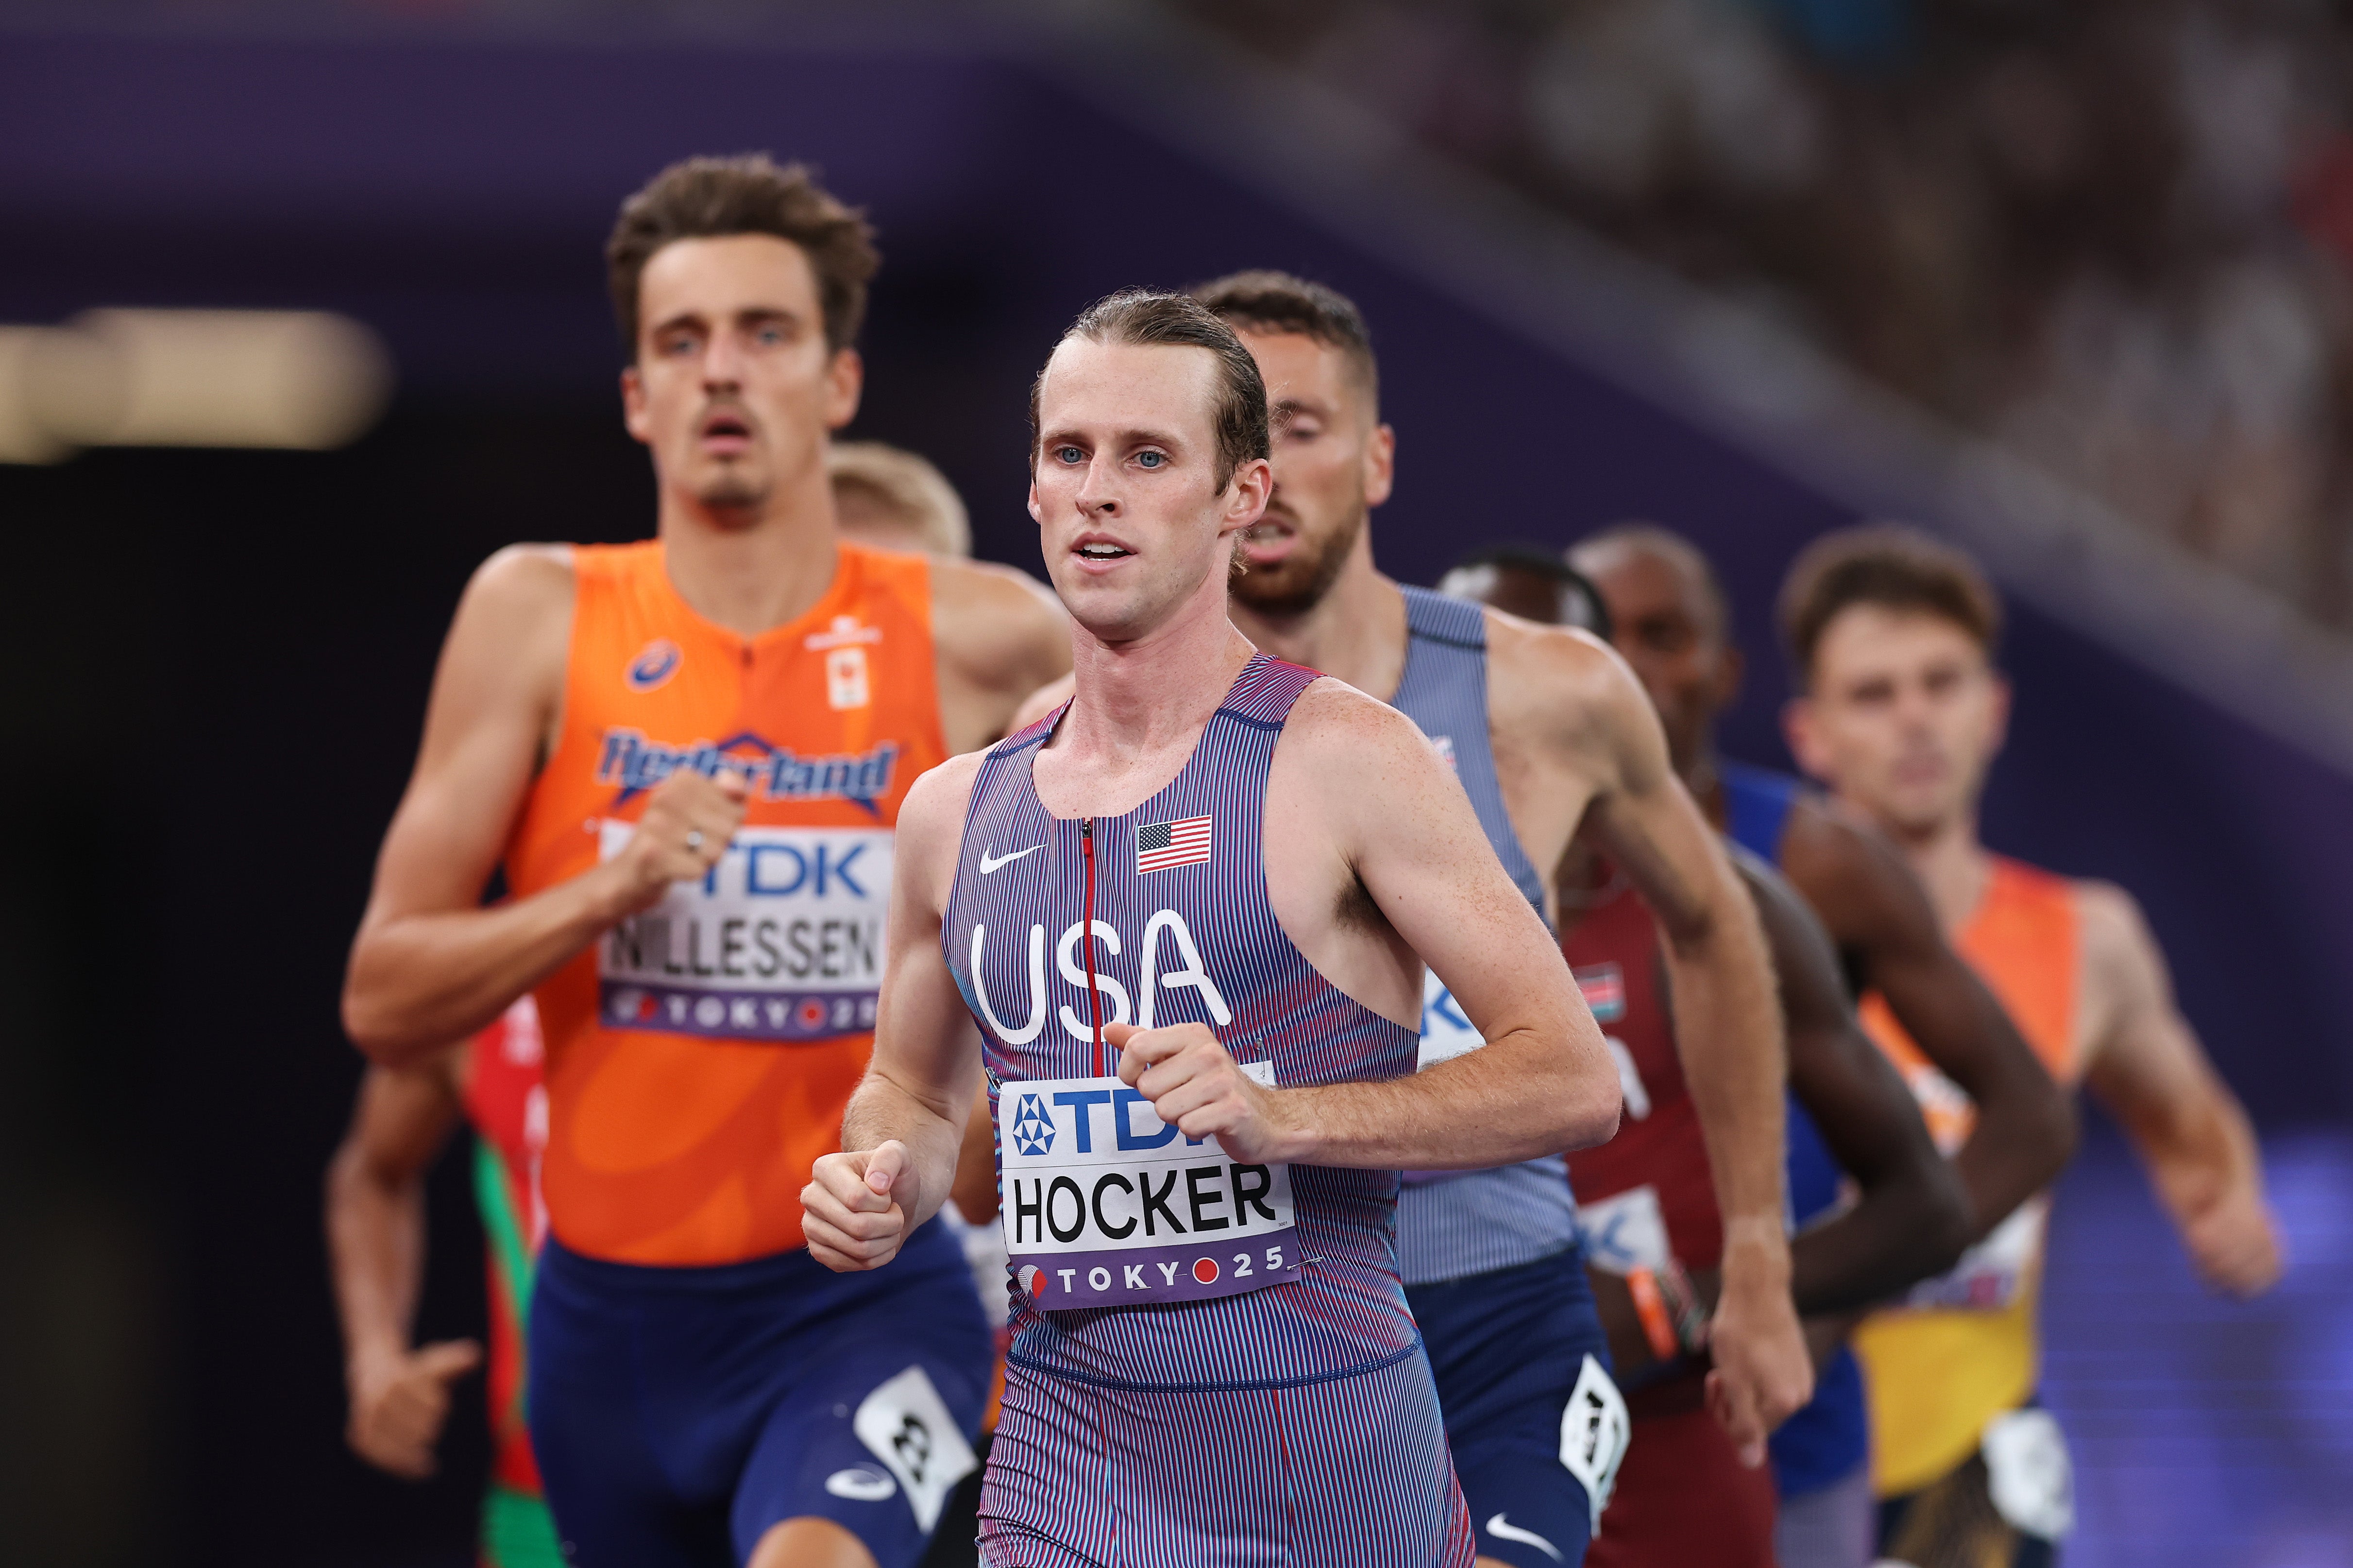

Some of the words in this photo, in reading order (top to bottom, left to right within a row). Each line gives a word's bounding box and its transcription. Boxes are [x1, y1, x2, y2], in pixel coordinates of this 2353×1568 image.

[971, 909, 1232, 1045] USA
[1053, 1089, 1203, 1153] TD
[1014, 1163, 1276, 1243] HOCKER
[1232, 1246, 1284, 1278] 25
